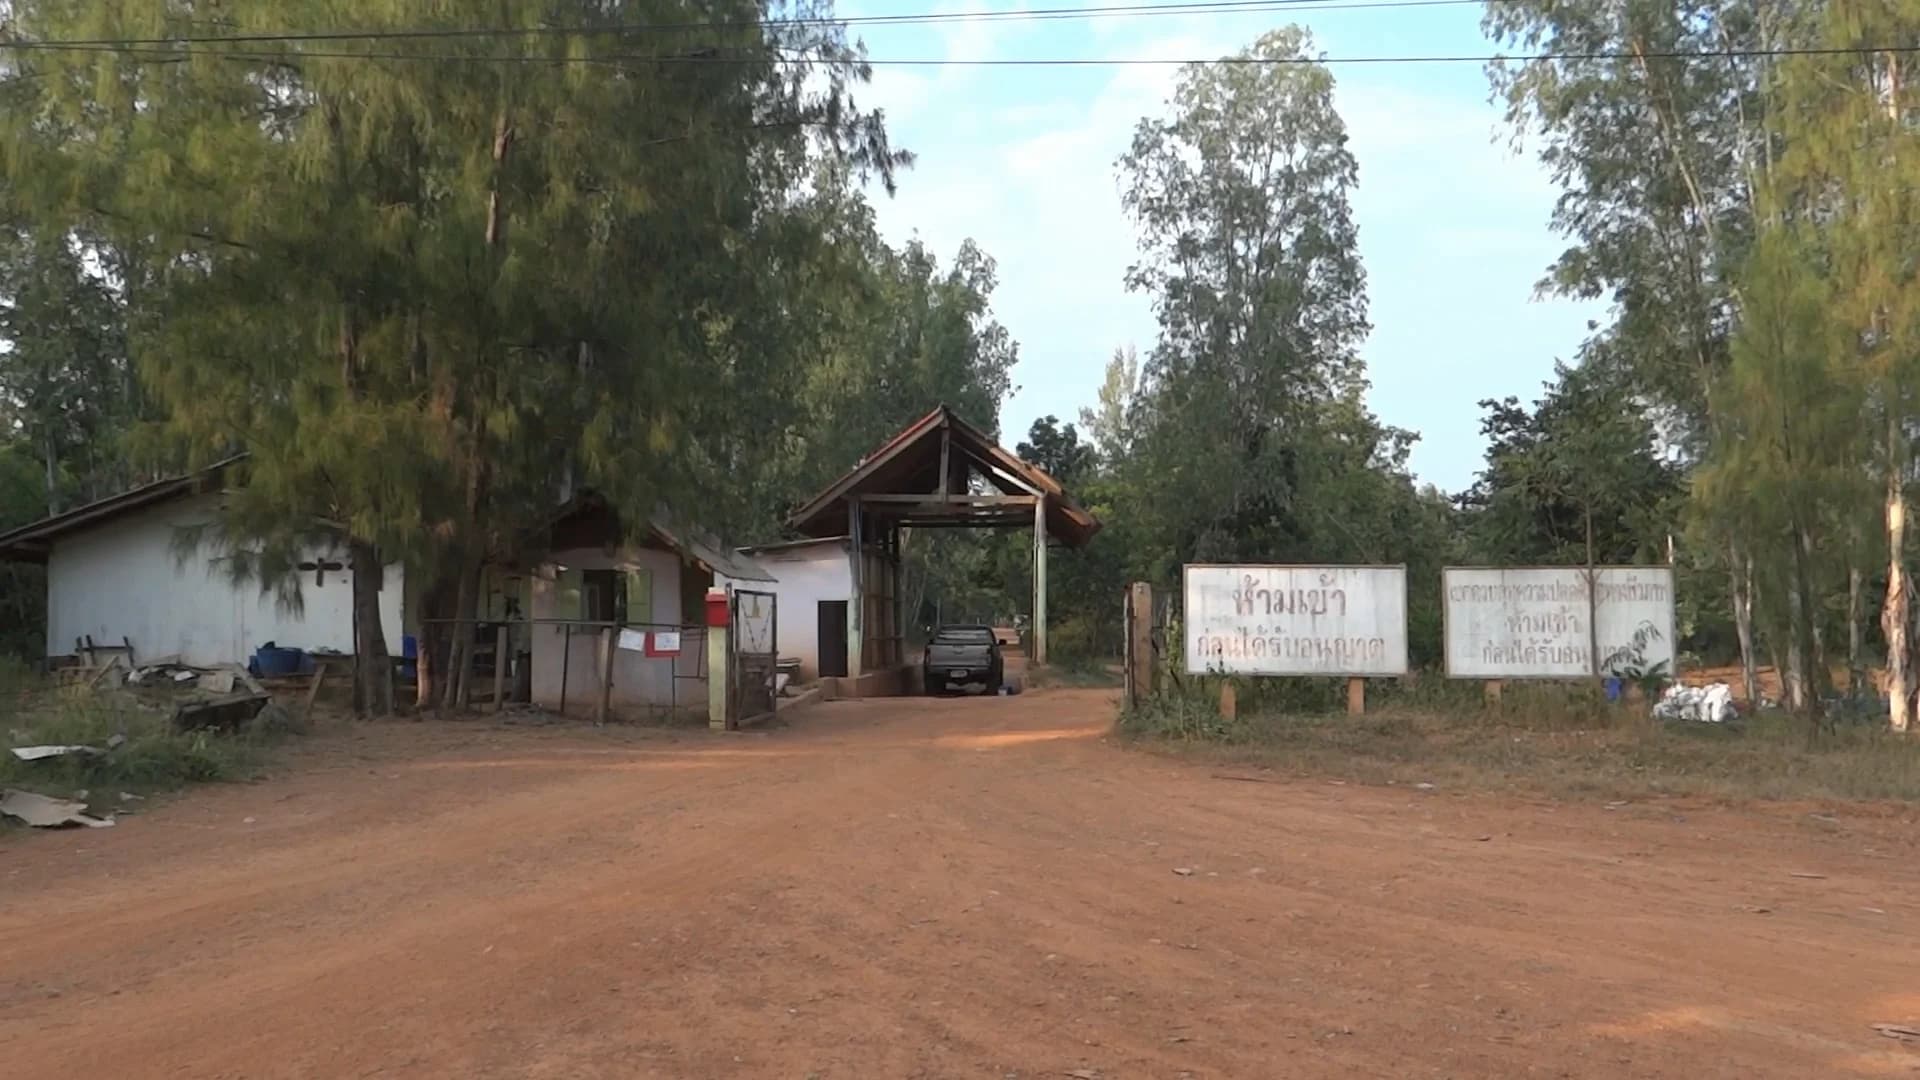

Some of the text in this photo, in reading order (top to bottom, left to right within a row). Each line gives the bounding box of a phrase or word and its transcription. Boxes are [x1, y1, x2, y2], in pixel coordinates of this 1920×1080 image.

[1232, 574, 1347, 616] ห้ามเข้า
[1505, 606, 1580, 641] ห้ามเข้า
[1197, 627, 1385, 666] ก่อนได้รับอนุญาต
